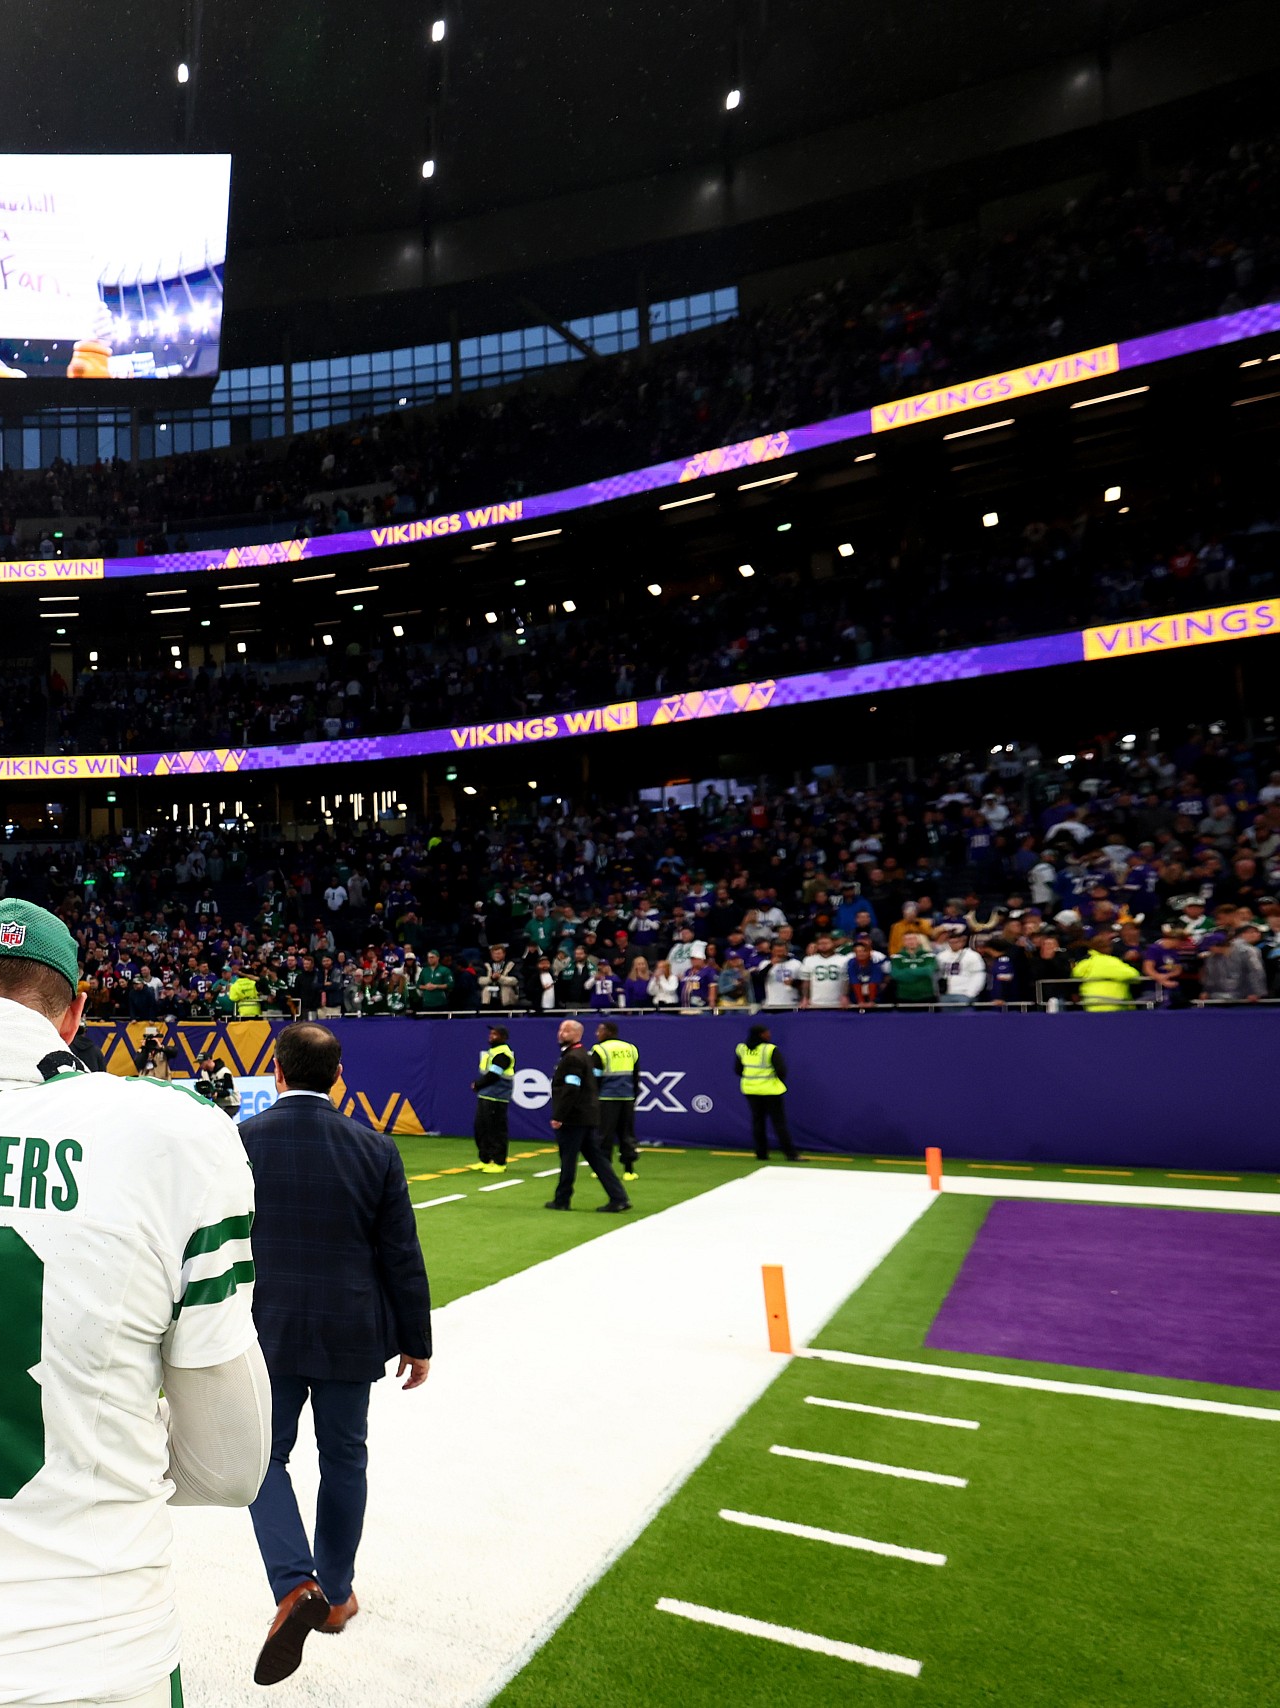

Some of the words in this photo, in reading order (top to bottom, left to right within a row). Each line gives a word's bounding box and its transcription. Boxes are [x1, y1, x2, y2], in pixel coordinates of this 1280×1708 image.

[879, 377, 1012, 424] VIKINGS
[1019, 351, 1108, 388] WIN!
[371, 512, 462, 548] VIKINGS
[466, 500, 524, 530] WIN!
[54, 560, 100, 577] WIN!
[1096, 604, 1276, 653] VIKINGS
[450, 717, 559, 750] VIKINGS
[563, 703, 634, 735] WIN!
[83, 756, 138, 775] WIN!
[201, 902, 211, 912] 91
[3, 933, 21, 945] NFL
[101, 976, 114, 989] 12
